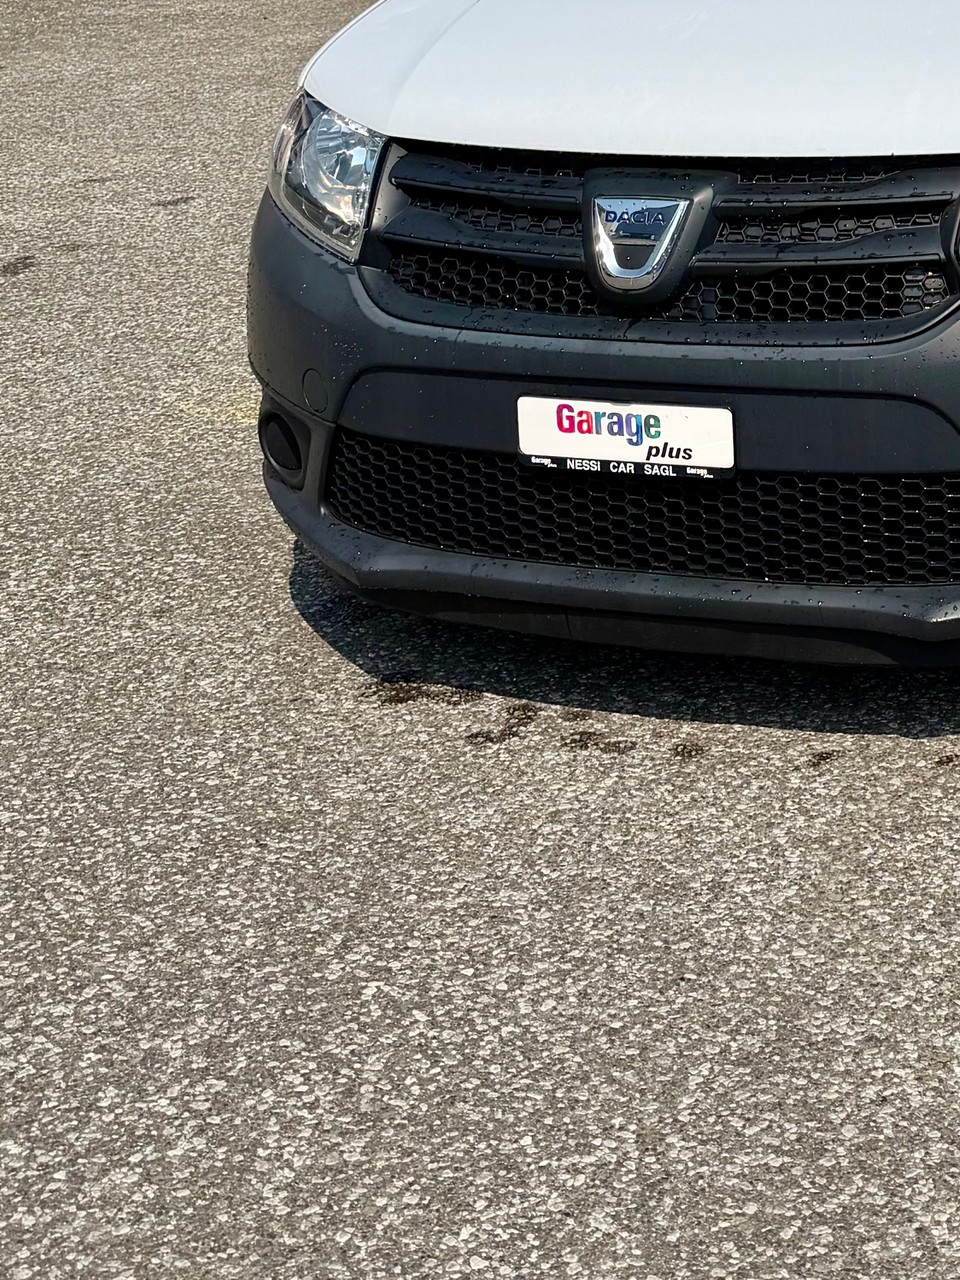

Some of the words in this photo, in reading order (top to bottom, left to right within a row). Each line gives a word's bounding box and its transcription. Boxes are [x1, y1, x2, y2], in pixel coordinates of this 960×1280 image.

[605, 210, 666, 225] DACIA
[556, 403, 661, 446] Garage
[646, 442, 693, 461] plus
[567, 459, 601, 471] NESSI
[610, 462, 635, 474] CAR
[644, 464, 677, 477] SAGL
